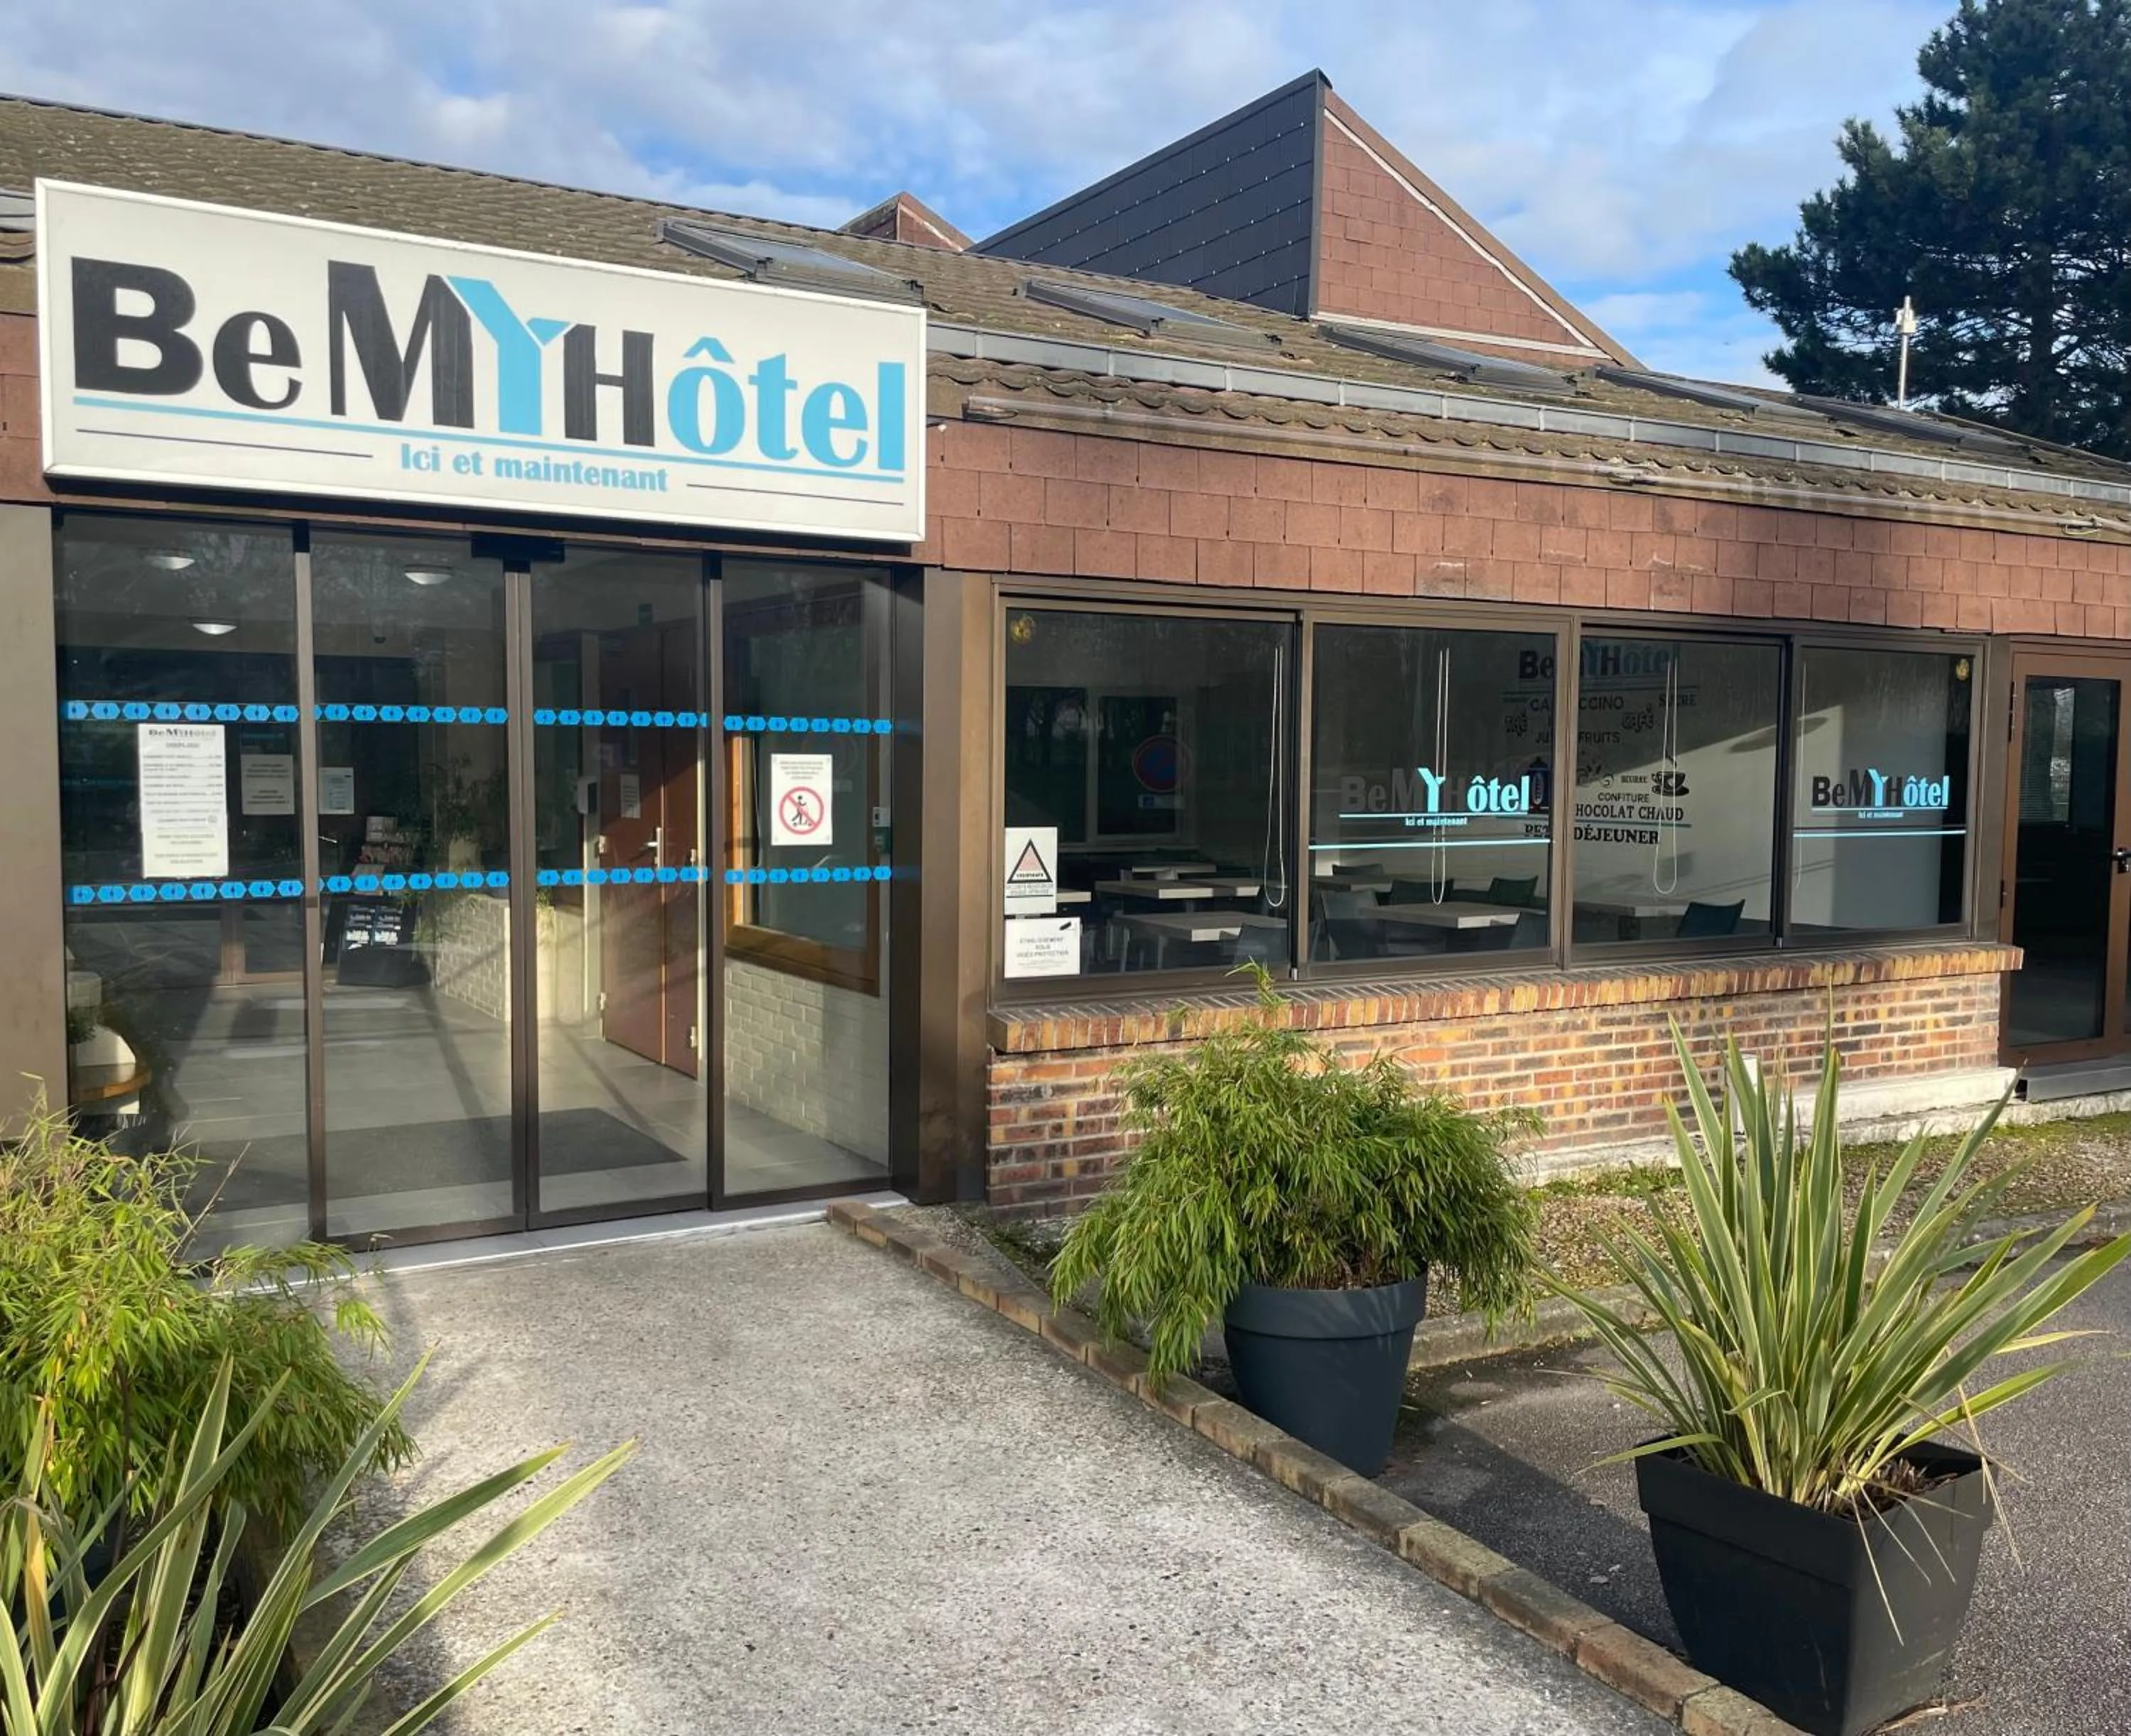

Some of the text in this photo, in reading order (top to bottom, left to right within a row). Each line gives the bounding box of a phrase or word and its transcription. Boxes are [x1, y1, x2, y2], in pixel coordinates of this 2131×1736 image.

[401, 443, 669, 492] Ici et maintenant
[1598, 791, 1650, 803] CONFITURE
[1576, 803, 1684, 821] HOCOLAT CHAUD
[1573, 823, 1659, 845] DÉJEUNER
